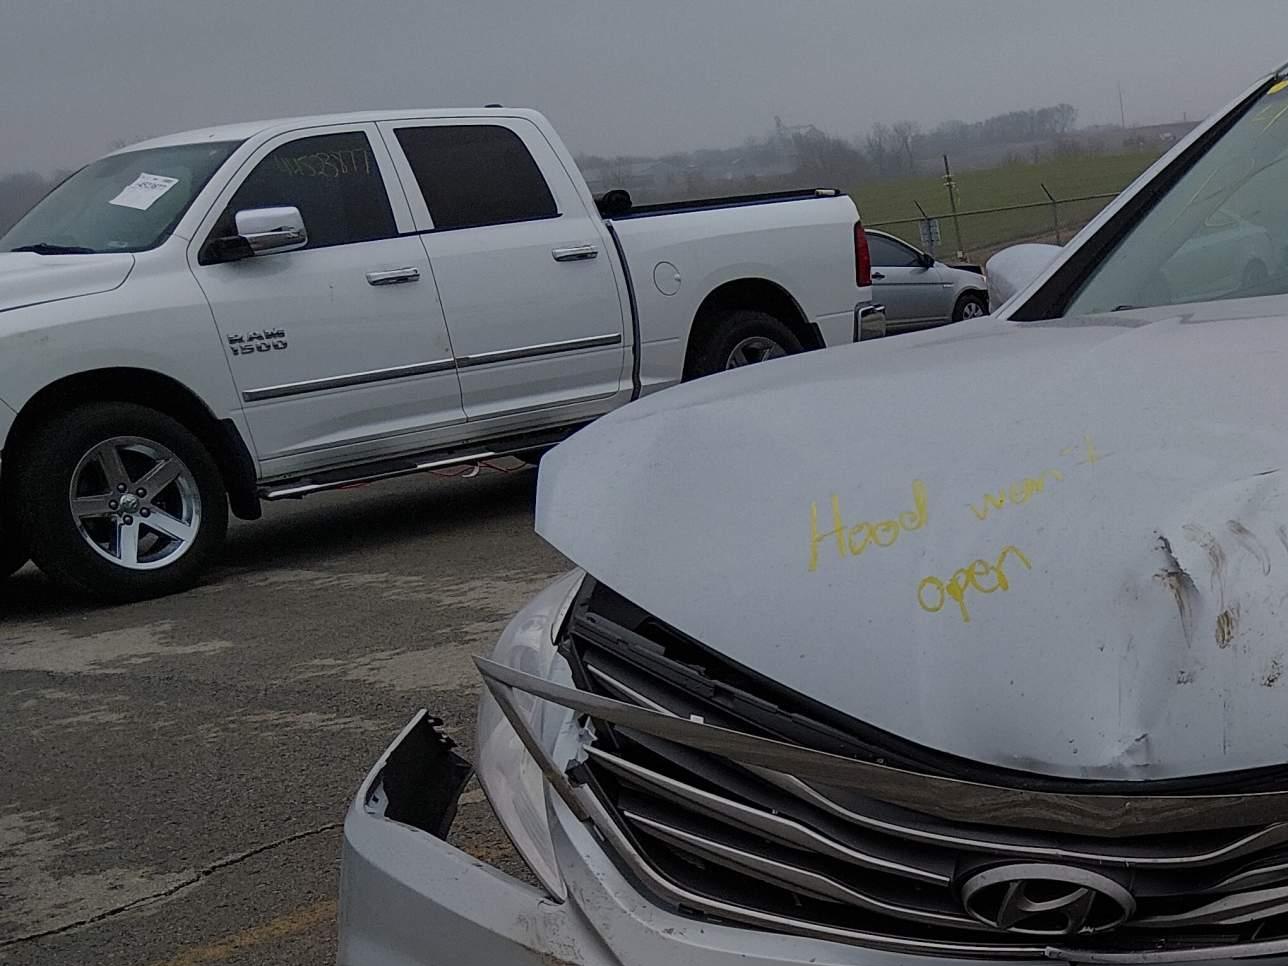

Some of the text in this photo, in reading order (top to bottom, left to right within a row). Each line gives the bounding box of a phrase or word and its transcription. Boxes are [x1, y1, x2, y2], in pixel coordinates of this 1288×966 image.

[227, 328, 286, 344] RAM
[229, 340, 288, 355] 1500
[808, 479, 928, 572] Hood
[917, 545, 1031, 623] open
